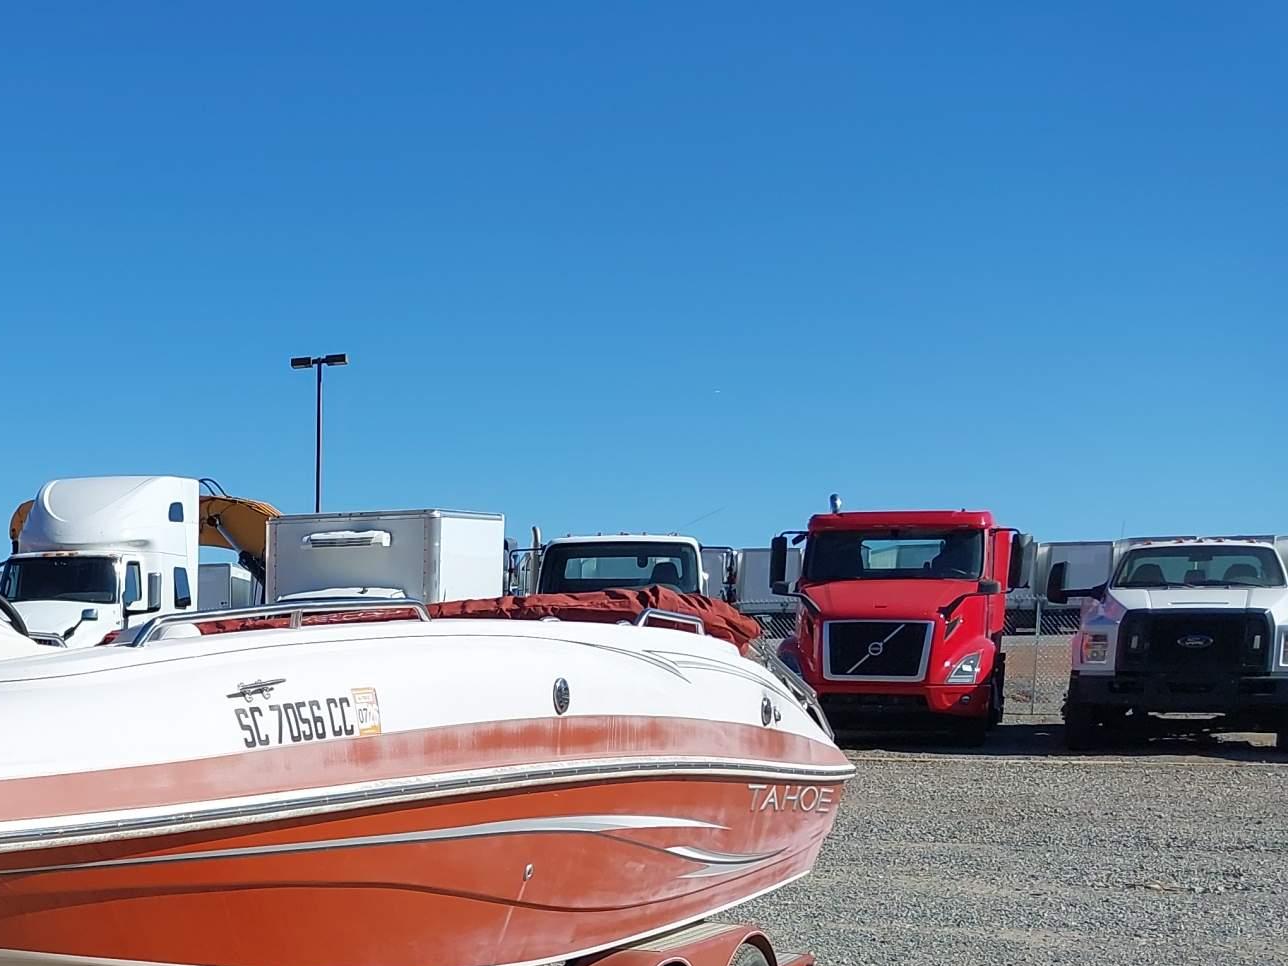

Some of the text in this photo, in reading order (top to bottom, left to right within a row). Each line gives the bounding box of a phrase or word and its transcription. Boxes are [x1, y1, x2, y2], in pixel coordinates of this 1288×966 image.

[234, 697, 355, 749] SC 7056 CC
[748, 784, 834, 813] TAHOE
